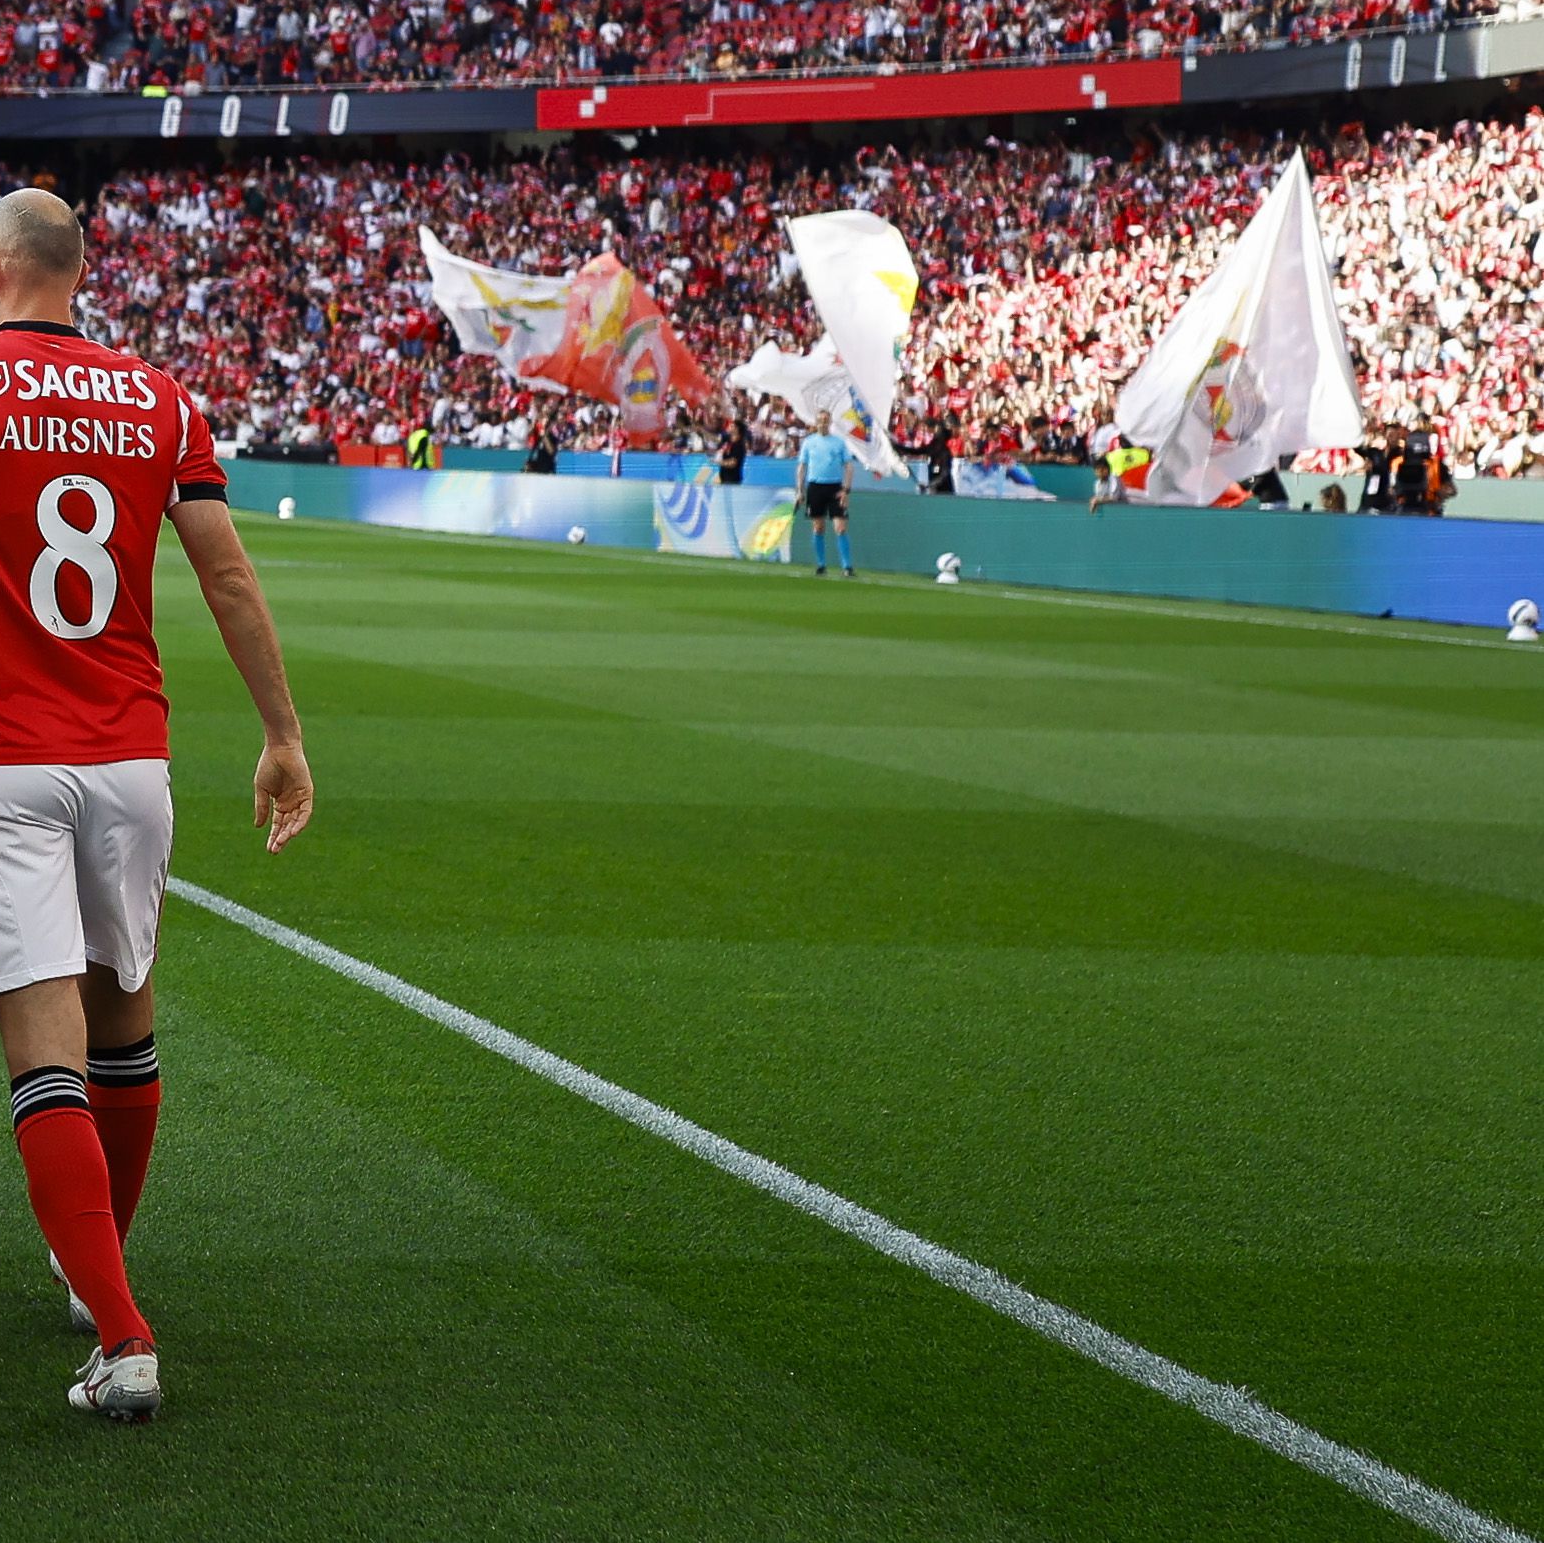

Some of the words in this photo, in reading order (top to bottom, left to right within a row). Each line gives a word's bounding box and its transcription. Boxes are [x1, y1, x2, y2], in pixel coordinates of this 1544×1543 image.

[160, 92, 351, 138] GOLO
[13, 359, 157, 411] SAGRES
[0, 415, 156, 460] AURSNES
[28, 473, 118, 640] 8
